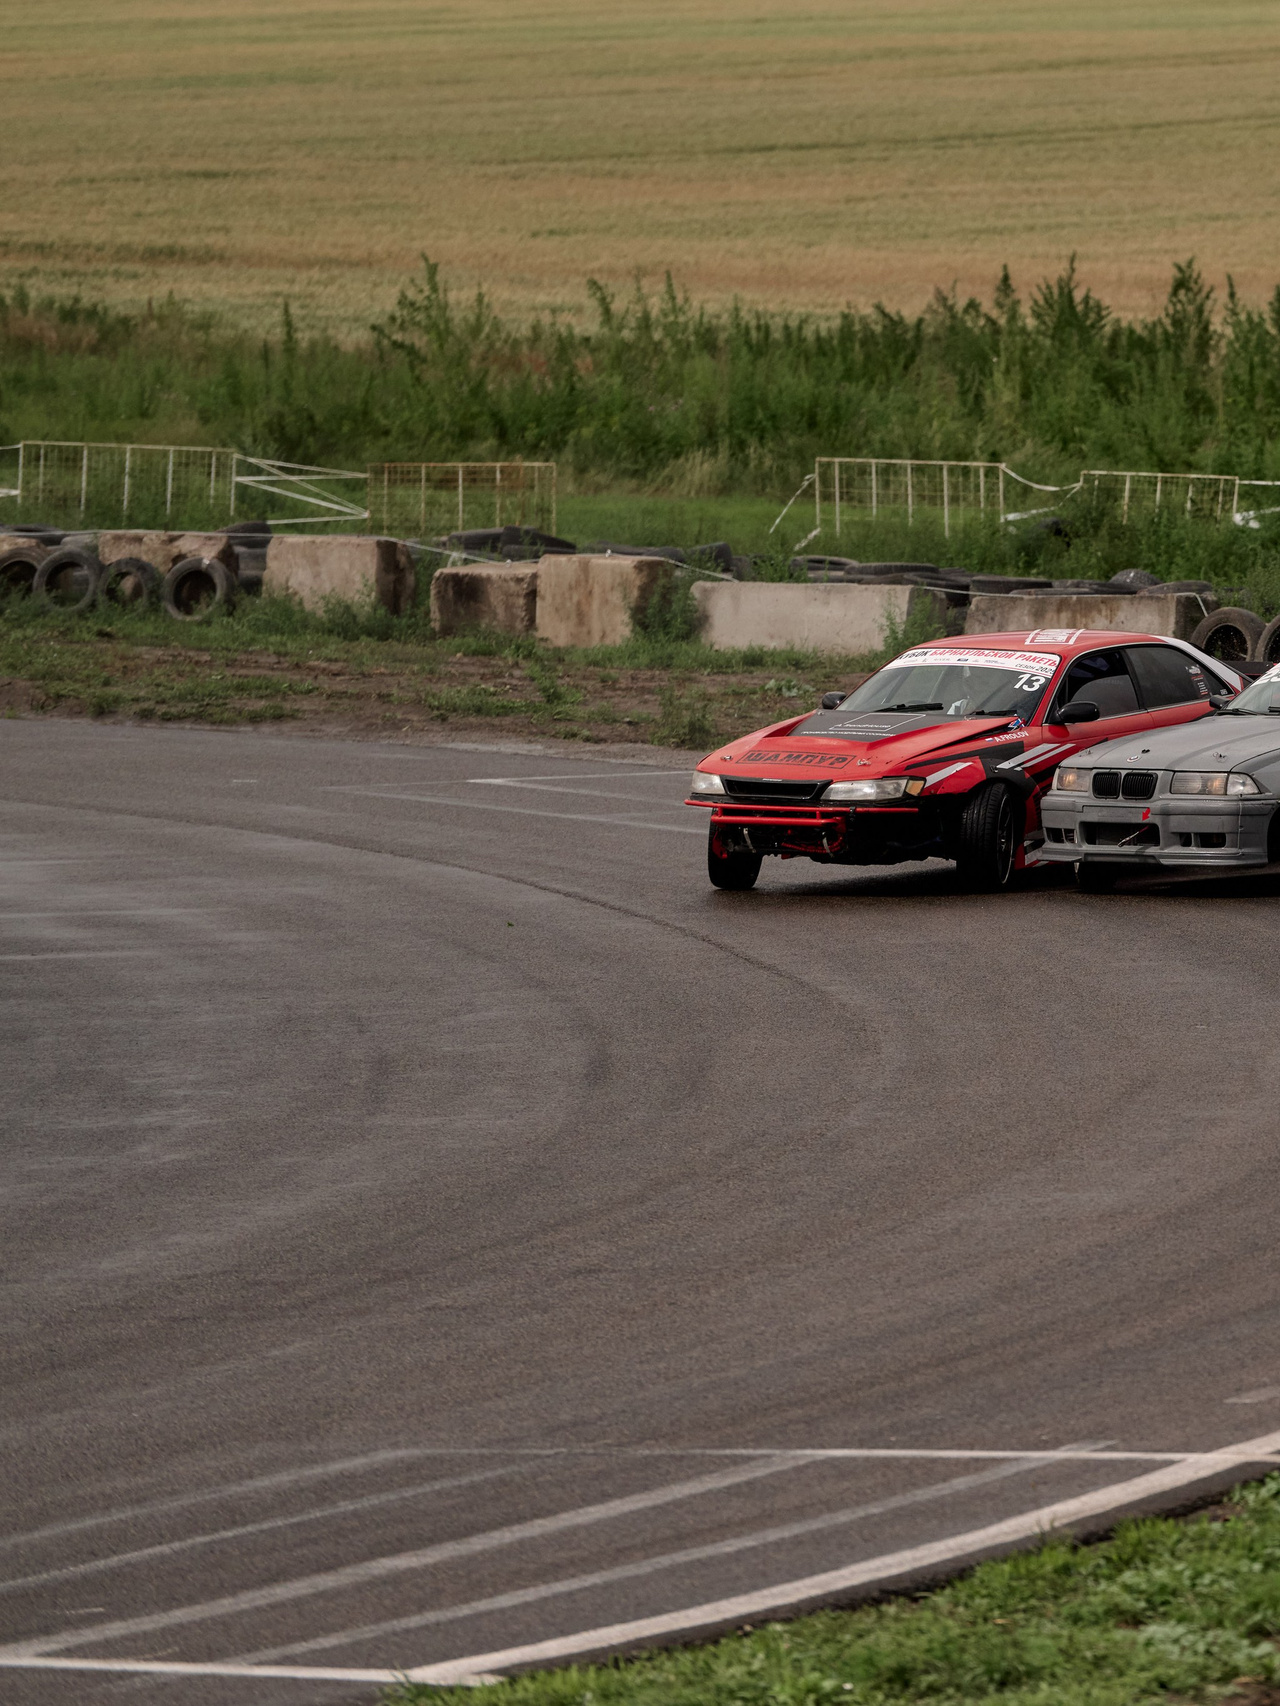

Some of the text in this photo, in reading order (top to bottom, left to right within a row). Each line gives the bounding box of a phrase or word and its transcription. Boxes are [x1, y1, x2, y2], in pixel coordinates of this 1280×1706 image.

[930, 649, 1016, 660] БАРНАУЛЬСКОЙ
[1013, 673, 1046, 692] 13
[743, 752, 849, 766] ШАМПУР
